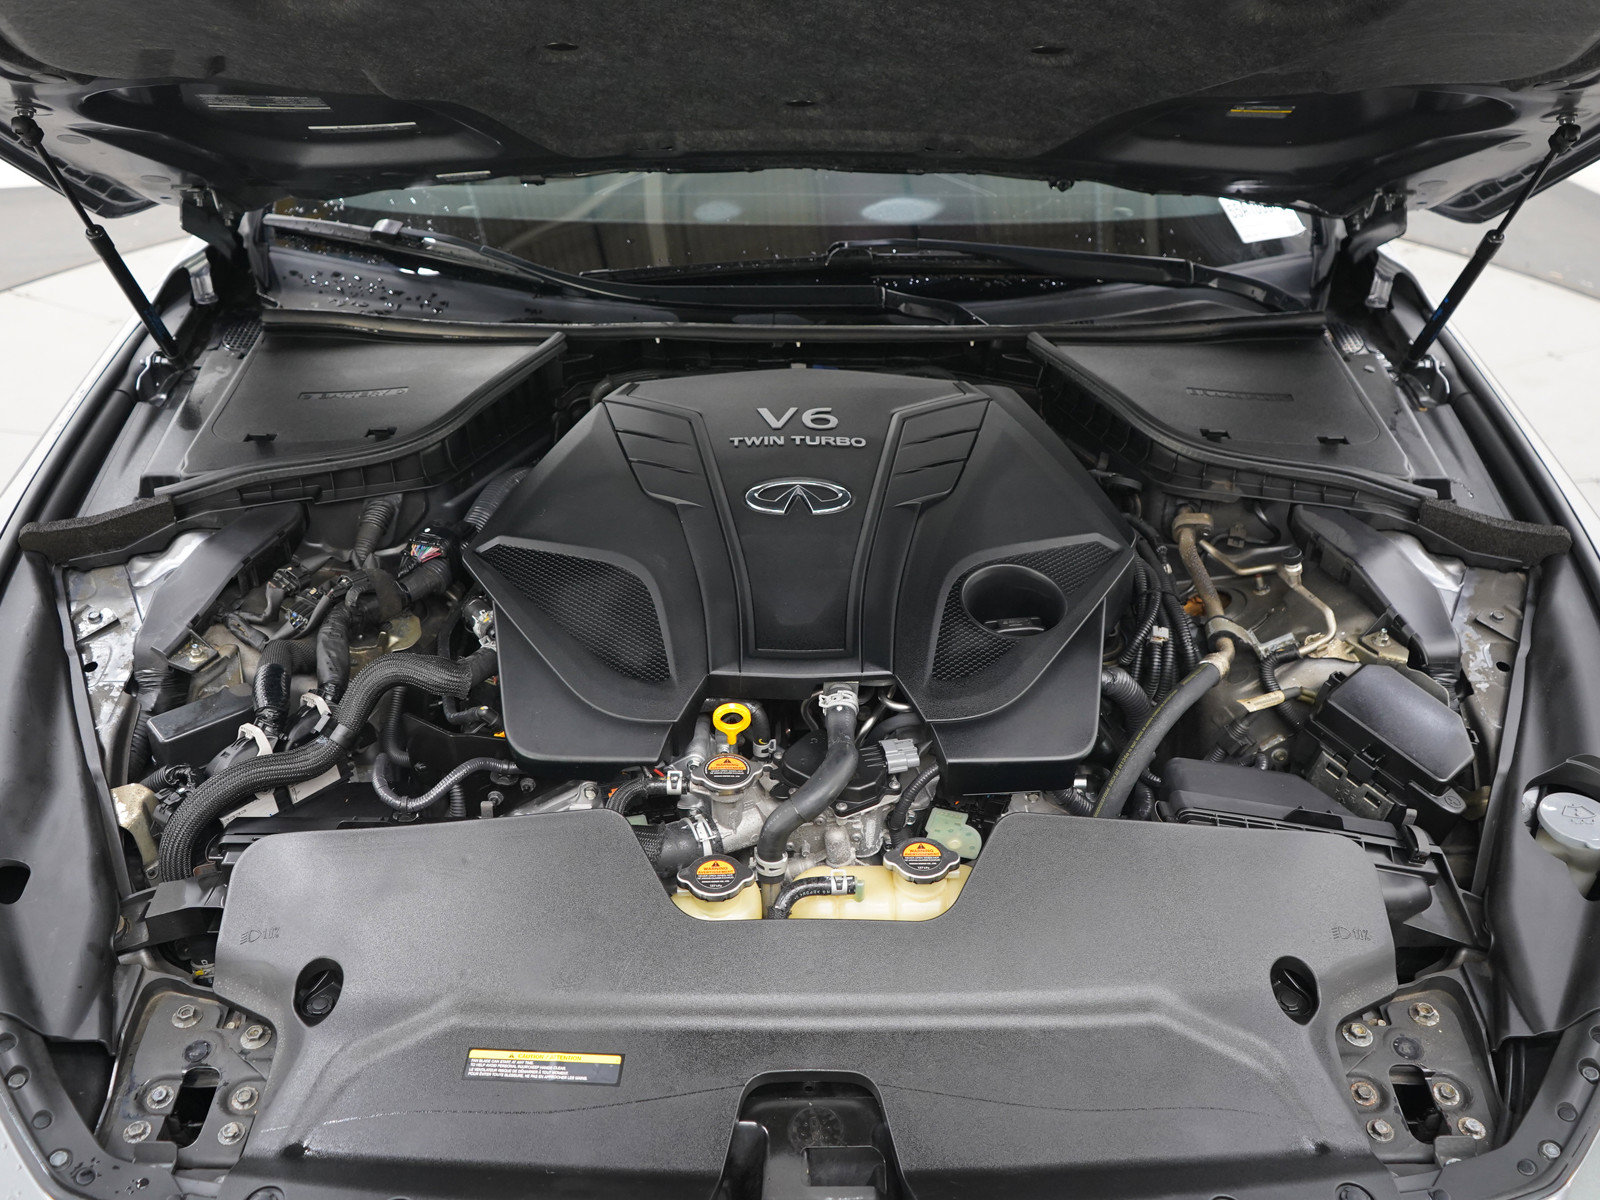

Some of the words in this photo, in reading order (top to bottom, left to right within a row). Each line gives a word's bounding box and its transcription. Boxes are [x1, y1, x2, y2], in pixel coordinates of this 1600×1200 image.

[757, 407, 839, 430] V6
[730, 436, 785, 447] TWIN
[791, 435, 867, 448] TURBO
